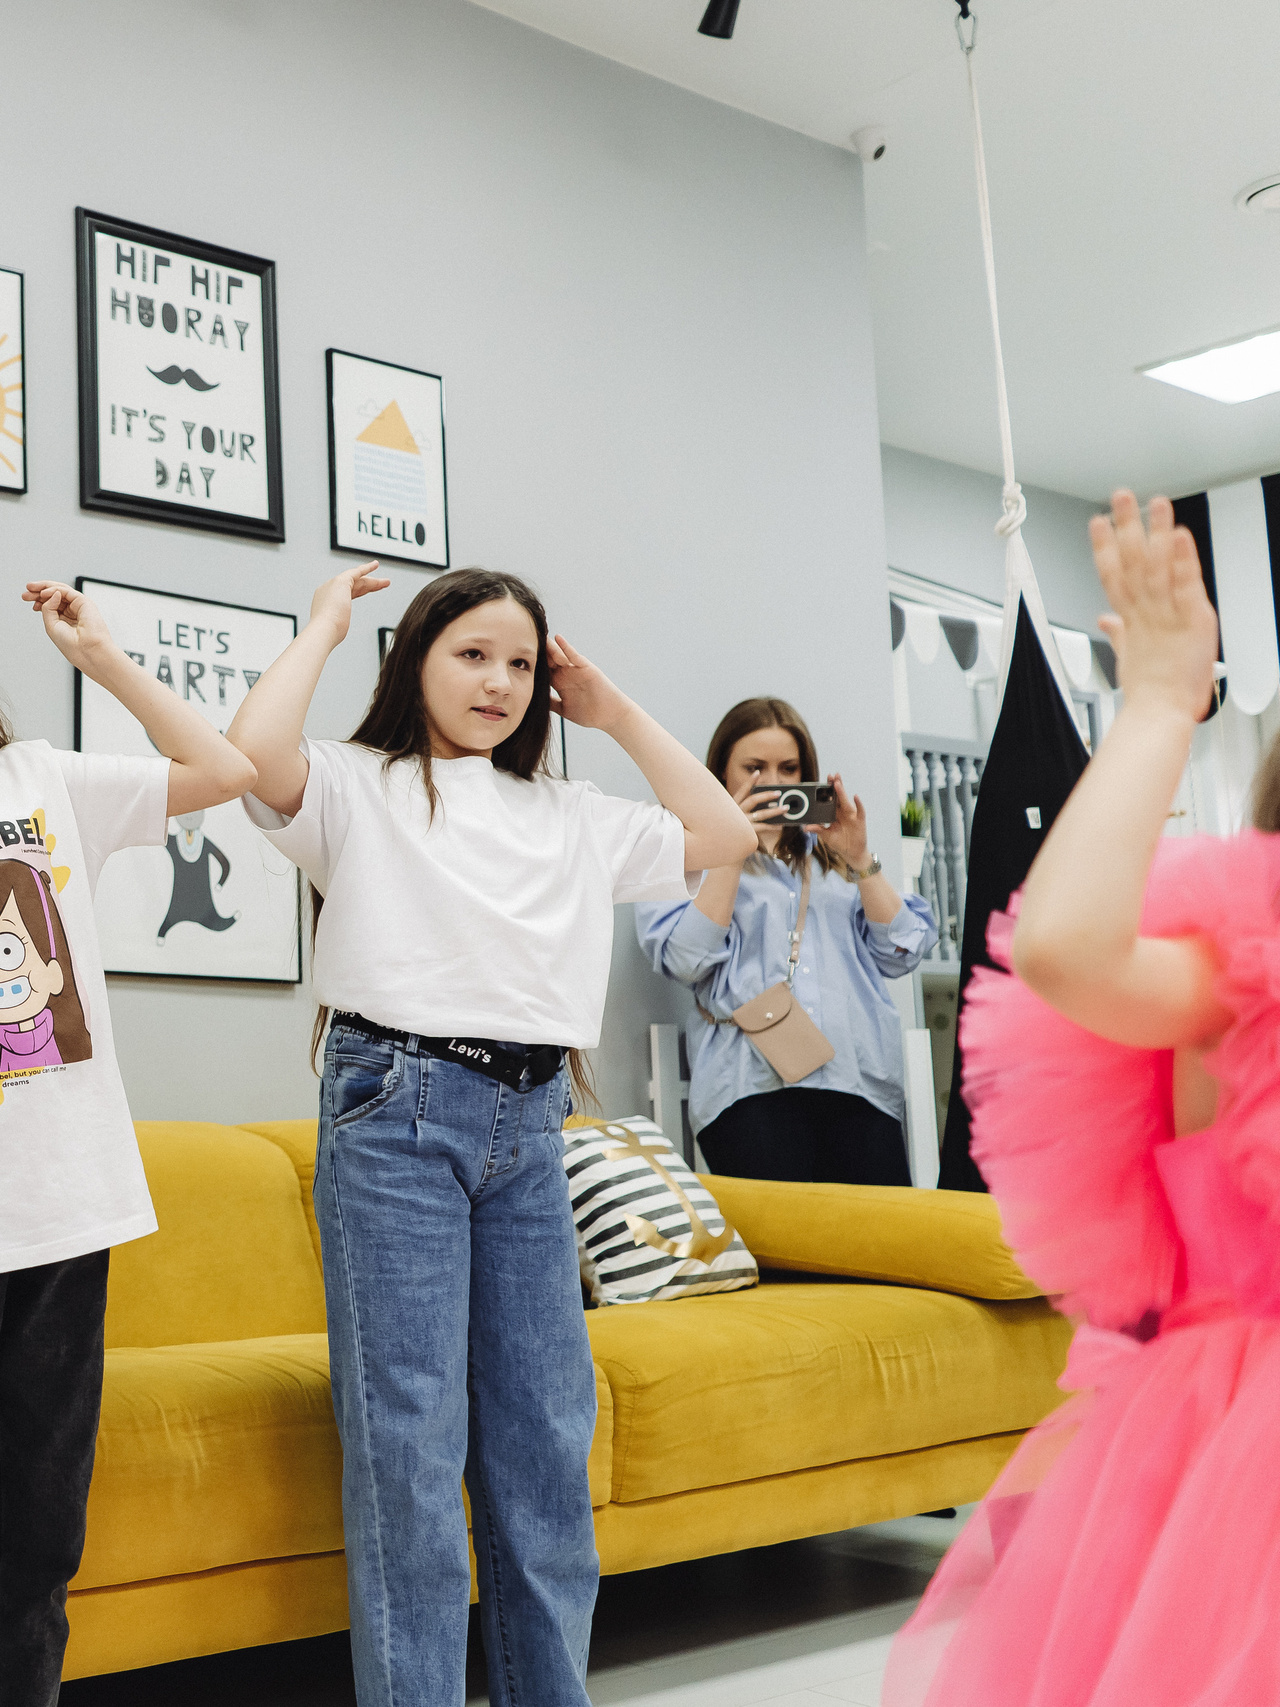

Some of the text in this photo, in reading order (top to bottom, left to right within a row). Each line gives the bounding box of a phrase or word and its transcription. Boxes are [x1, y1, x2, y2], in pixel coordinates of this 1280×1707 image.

[116, 242, 243, 305] HIP HIP
[110, 403, 257, 464] IT'S YOUR
[155, 457, 215, 498] DAY
[158, 620, 230, 654] LET'S
[448, 1039, 492, 1064] Levi's
[1, 1080, 30, 1089] dreams
[28, 1069, 41, 1078] you
